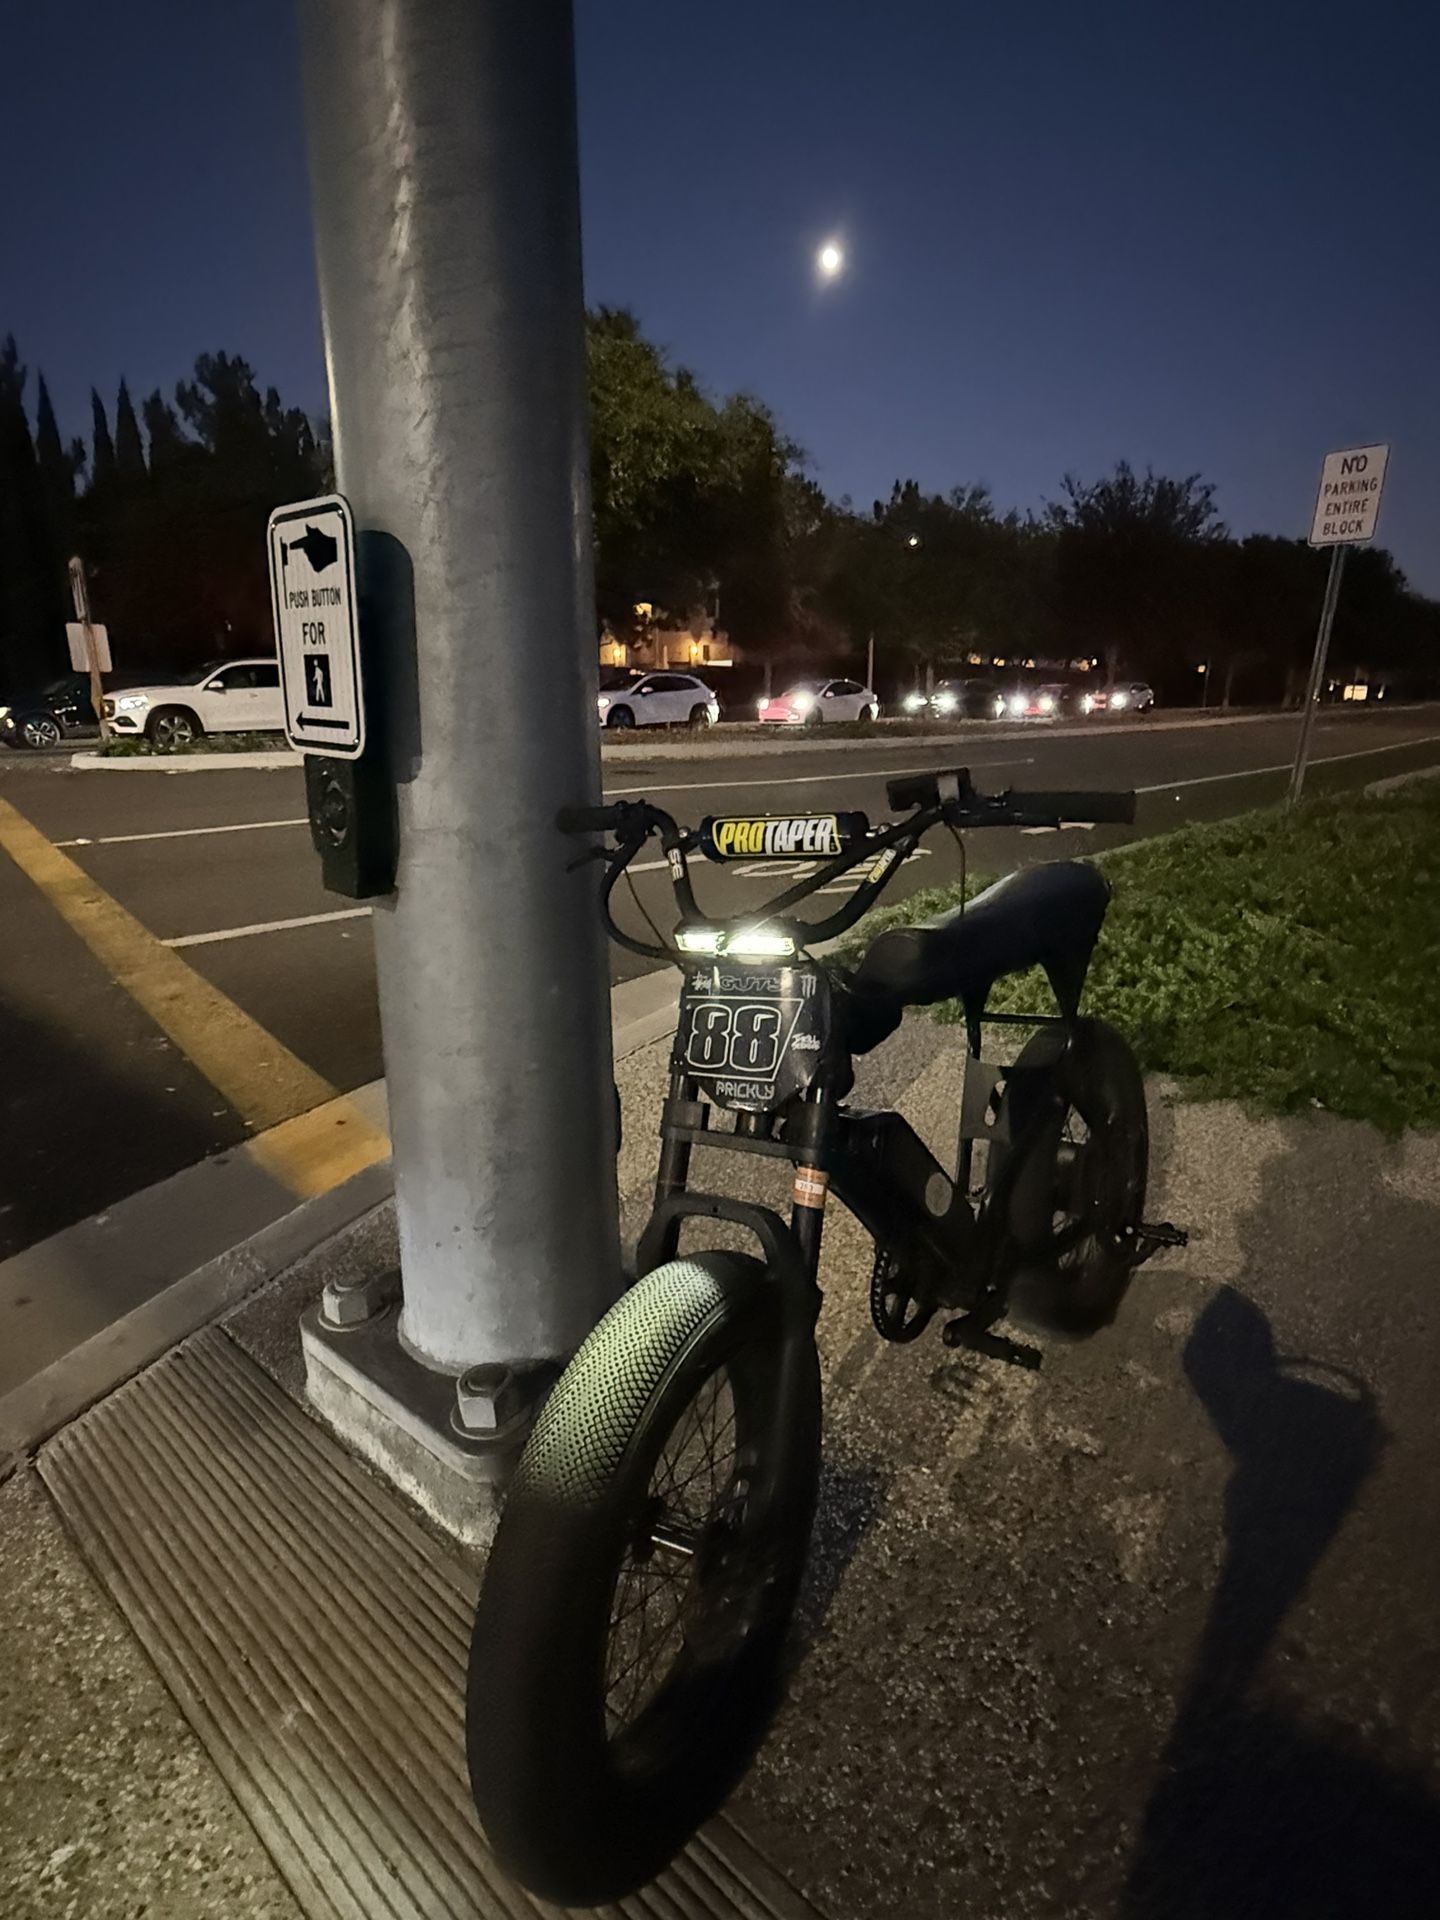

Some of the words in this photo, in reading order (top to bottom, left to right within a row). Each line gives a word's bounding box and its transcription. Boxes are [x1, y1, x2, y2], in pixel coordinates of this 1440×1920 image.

[1341, 455, 1368, 475] NO
[1324, 477, 1378, 496] PARKING
[1325, 498, 1369, 516] ENTIRE
[1322, 520, 1363, 536] BLOCK
[289, 590, 309, 609] PUSH
[312, 587, 342, 607] BUTTON
[302, 622, 326, 645] FOR
[719, 818, 834, 855] PROTAPER
[687, 1004, 782, 1072] 88
[715, 1080, 775, 1100] PRICKLY
